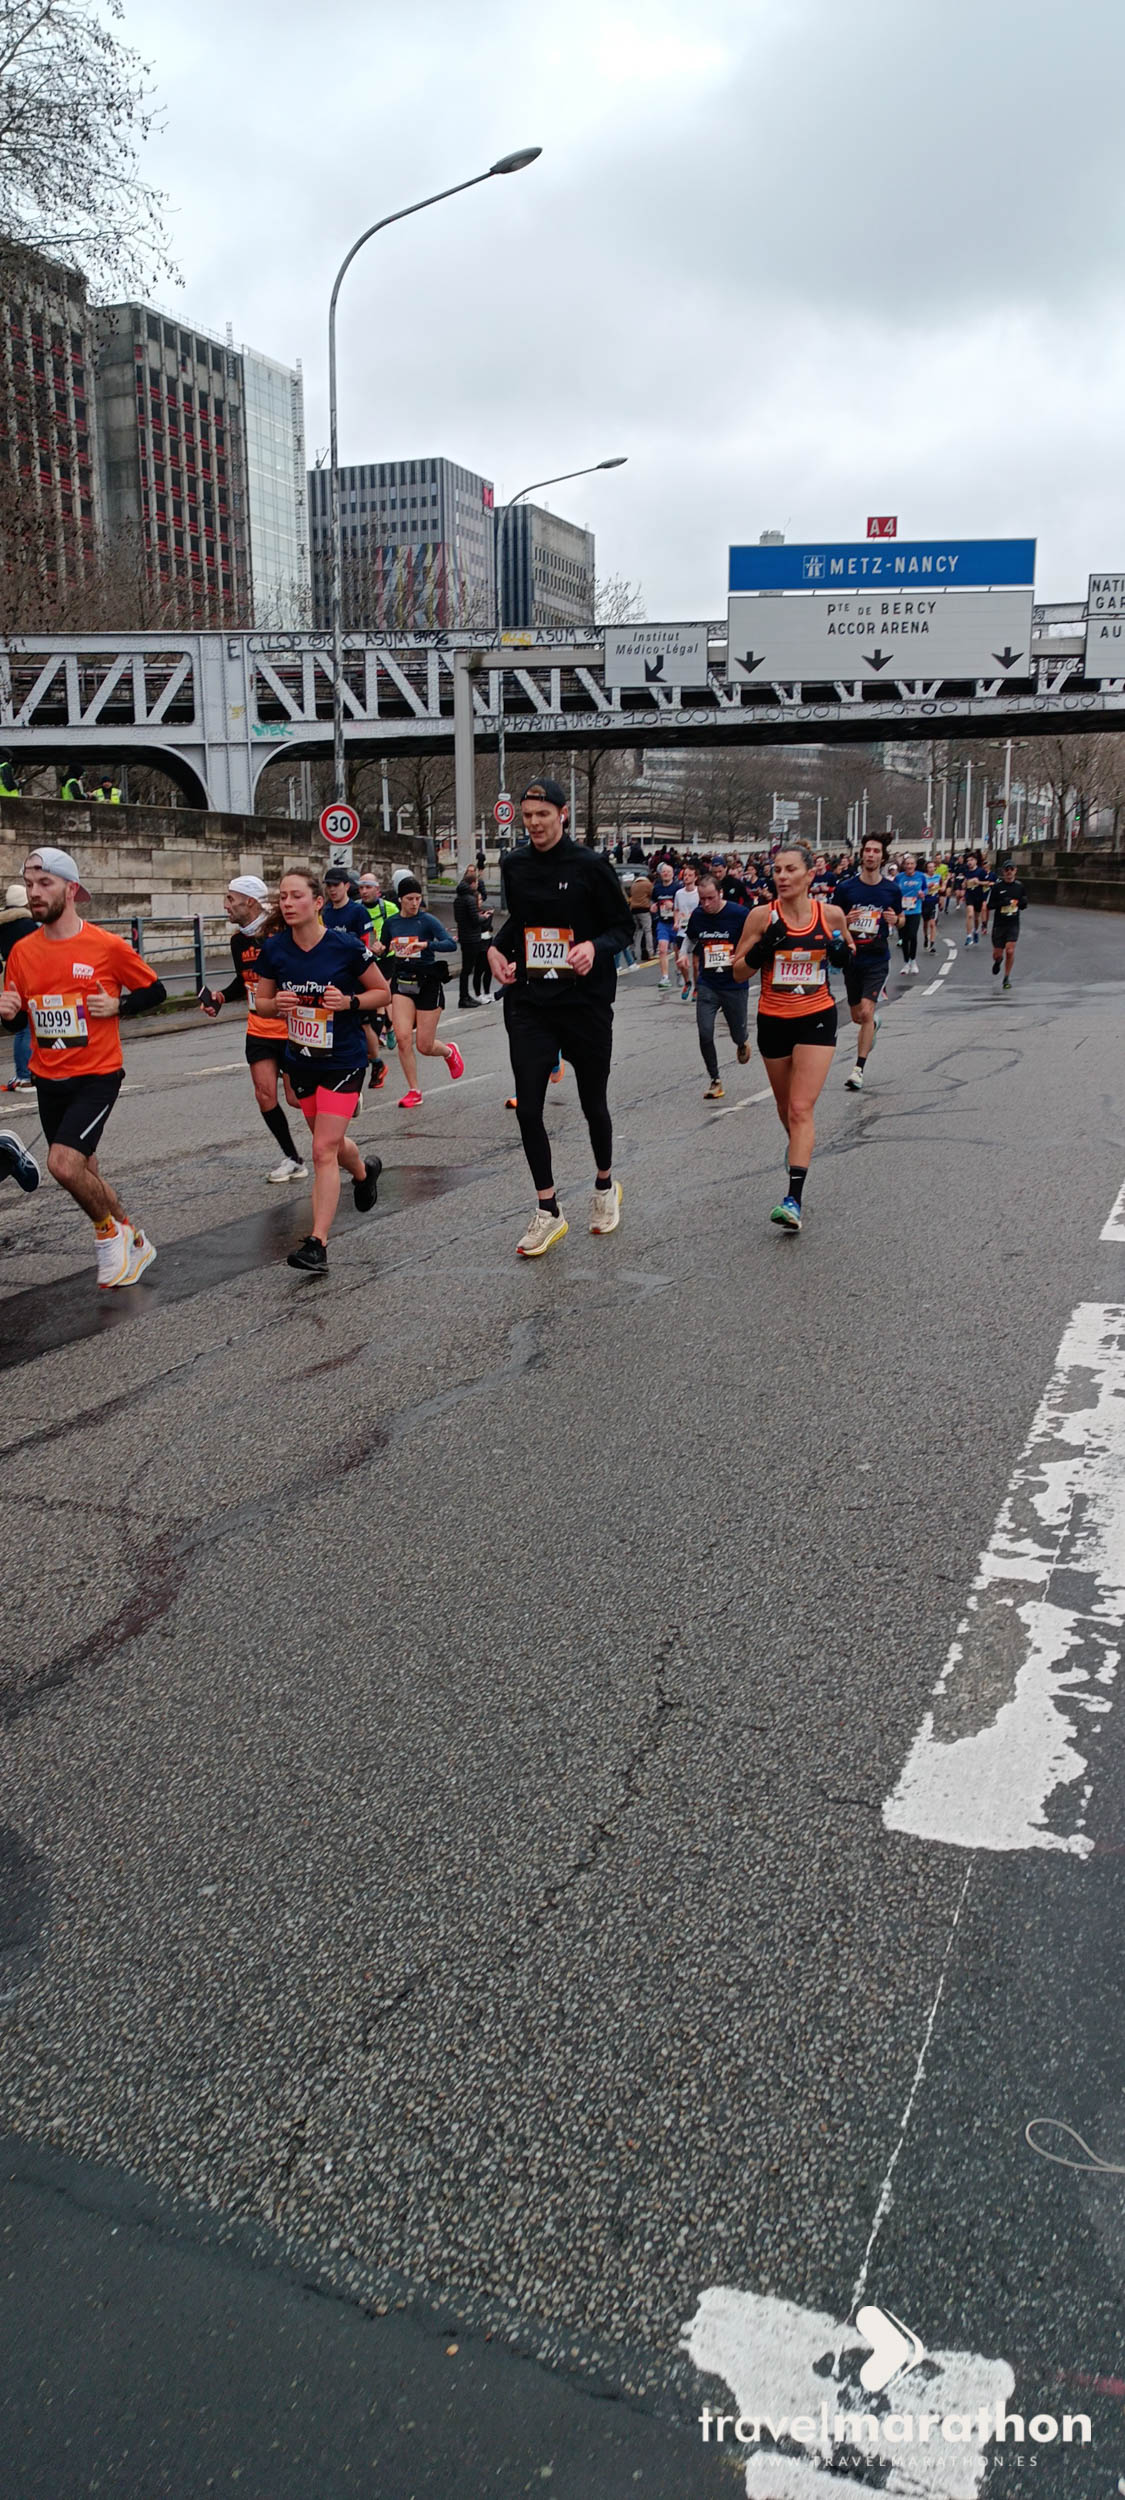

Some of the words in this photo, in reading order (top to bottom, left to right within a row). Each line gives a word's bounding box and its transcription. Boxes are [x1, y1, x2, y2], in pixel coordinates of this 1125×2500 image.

[869, 518, 896, 536] A4
[829, 555, 960, 575] METZ-NANCY
[858, 606, 872, 616] DE
[881, 600, 937, 615] BERCY
[827, 622, 876, 635] ACCOR
[881, 621, 930, 635] ARENA
[633, 631, 680, 642] Institut
[615, 642, 699, 657] Médico-Légal
[498, 806, 510, 818] 30
[328, 815, 351, 832] 30
[532, 942, 565, 959] 20327
[780, 962, 813, 976] 17878
[35, 1009, 71, 1028] 22999
[289, 1017, 320, 1039] 17002
